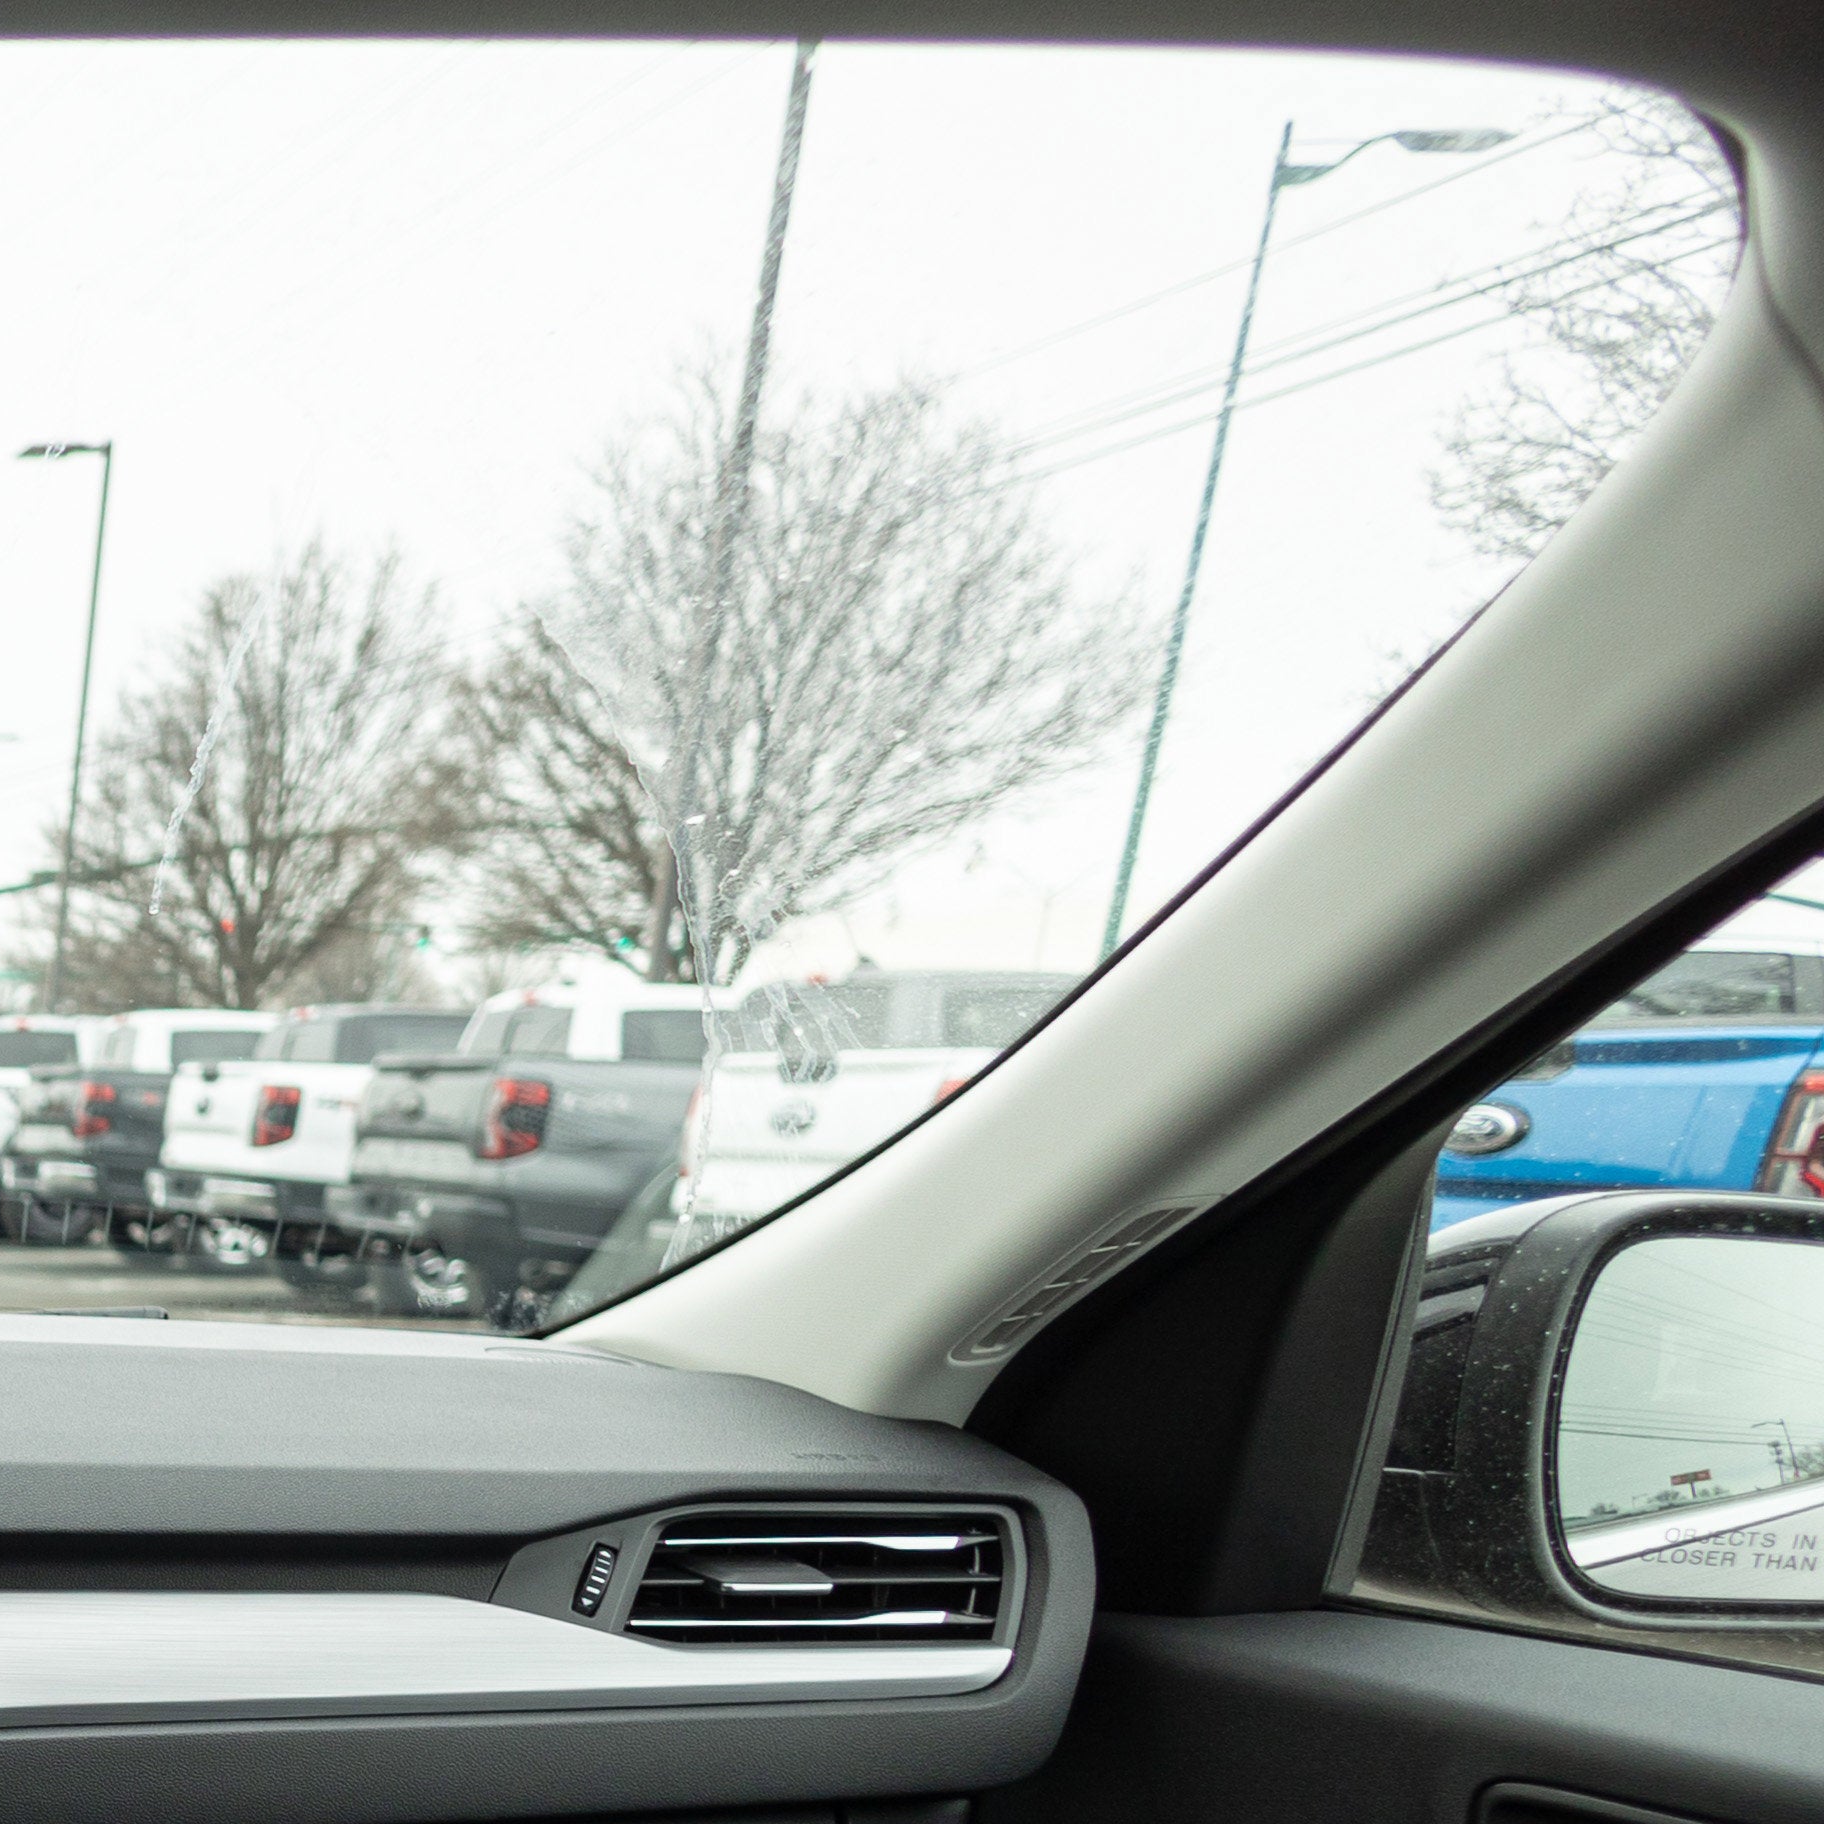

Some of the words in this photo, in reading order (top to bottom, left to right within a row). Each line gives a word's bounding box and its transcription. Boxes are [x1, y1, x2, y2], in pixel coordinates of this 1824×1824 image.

[1792, 1534, 1818, 1550] IN
[1640, 1548, 1737, 1568] CLOSER
[1752, 1552, 1818, 1571] THAN
